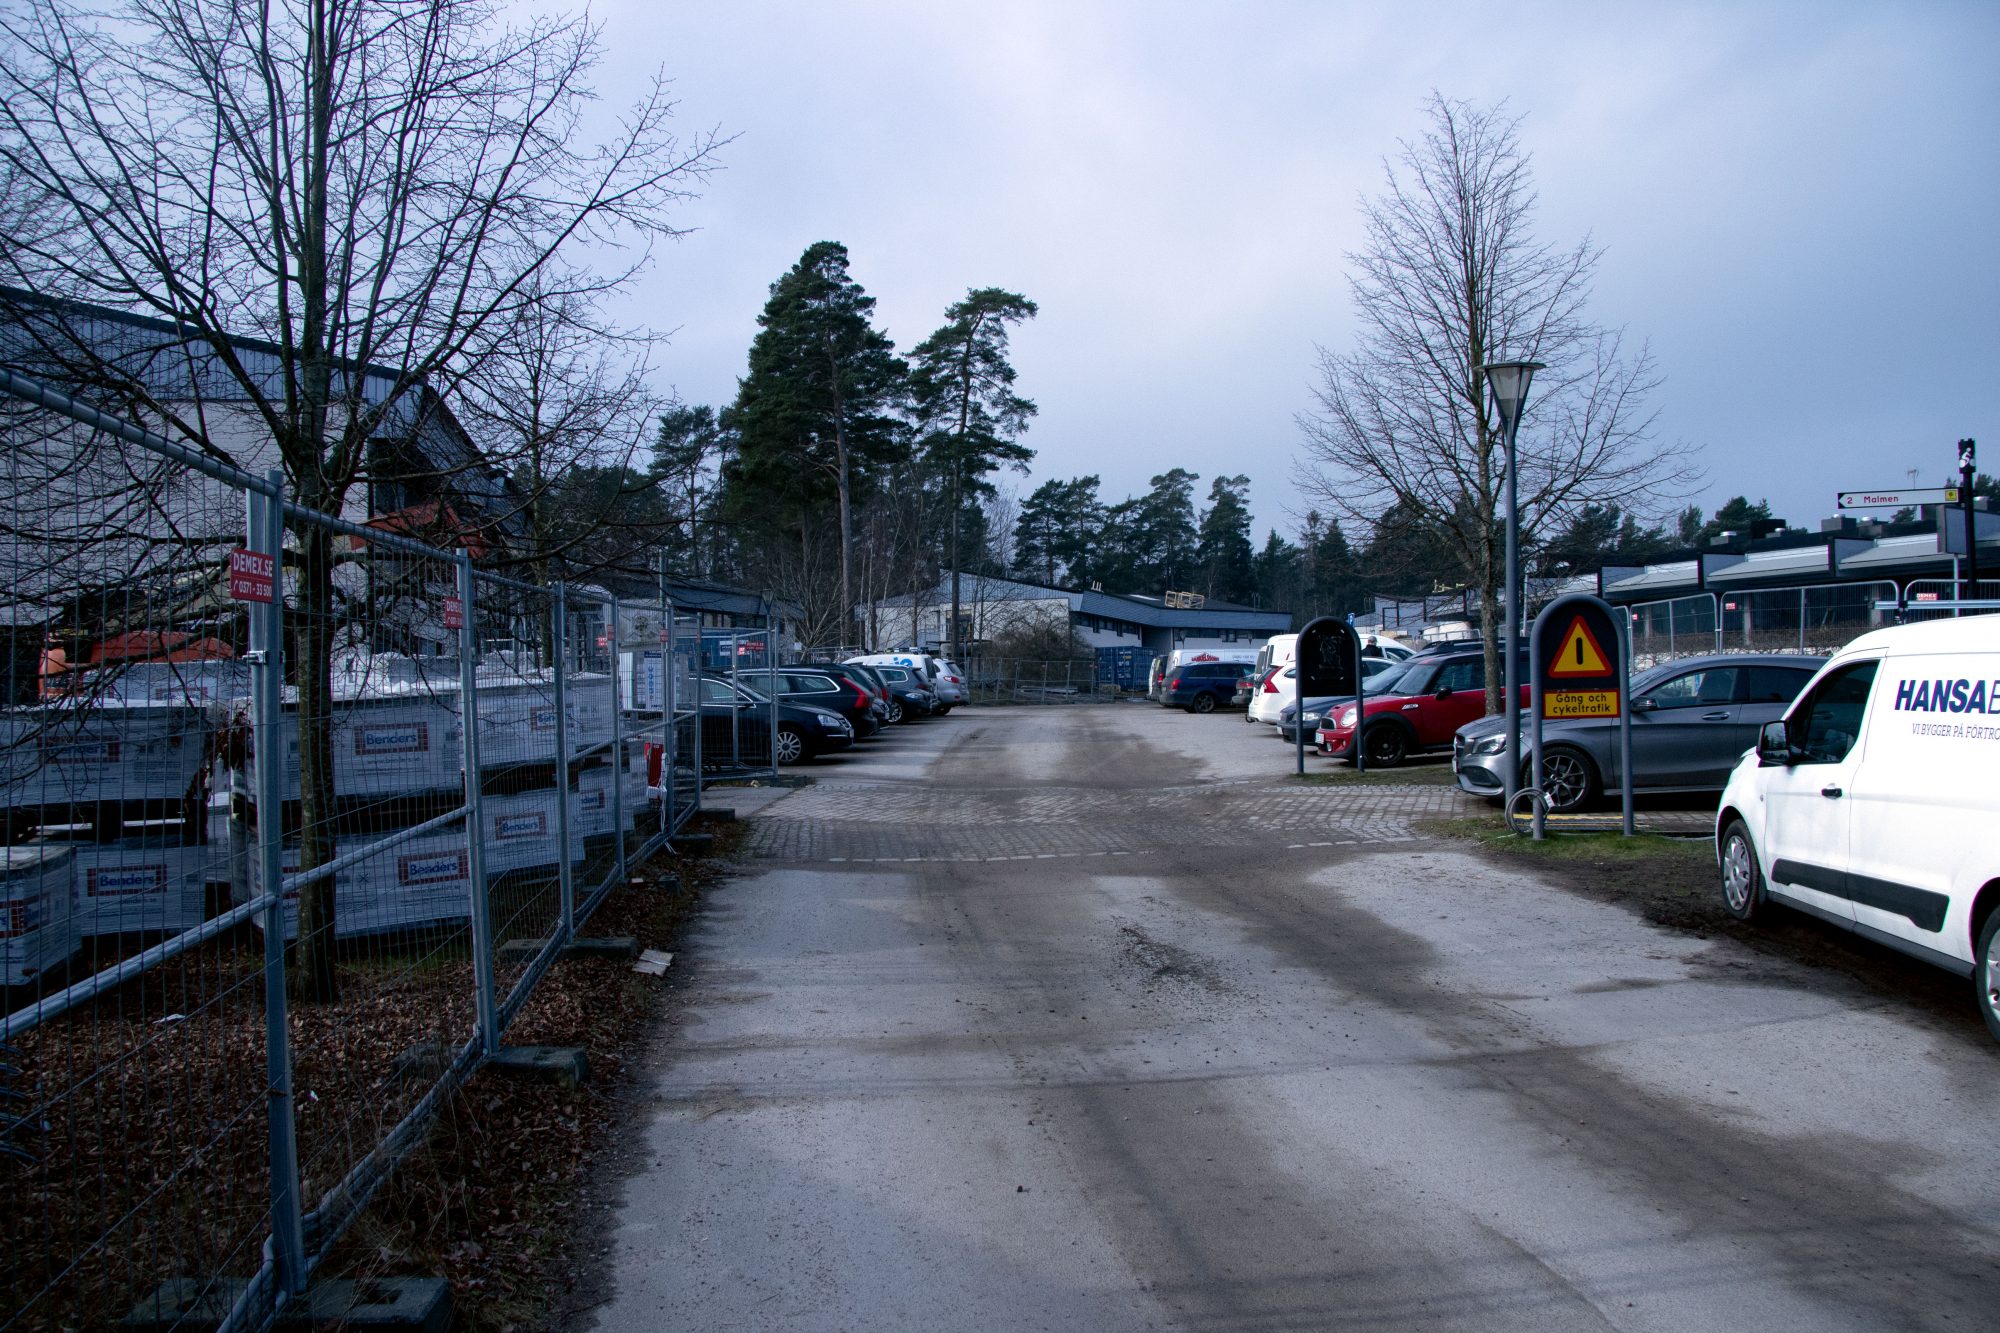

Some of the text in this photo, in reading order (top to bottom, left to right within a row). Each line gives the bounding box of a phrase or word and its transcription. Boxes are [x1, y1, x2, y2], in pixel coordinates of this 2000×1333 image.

[1864, 495, 1899, 504] Malmen
[233, 552, 273, 577] DEMEX.SE
[1556, 693, 1607, 704] Gång och
[1553, 703, 1611, 715] cykeltrafik
[1912, 723, 1921, 735] VI
[1921, 723, 1952, 737] BYGGER
[1953, 722, 1964, 738] PÅ
[366, 731, 417, 745] Benders
[100, 873, 154, 887] Benders
